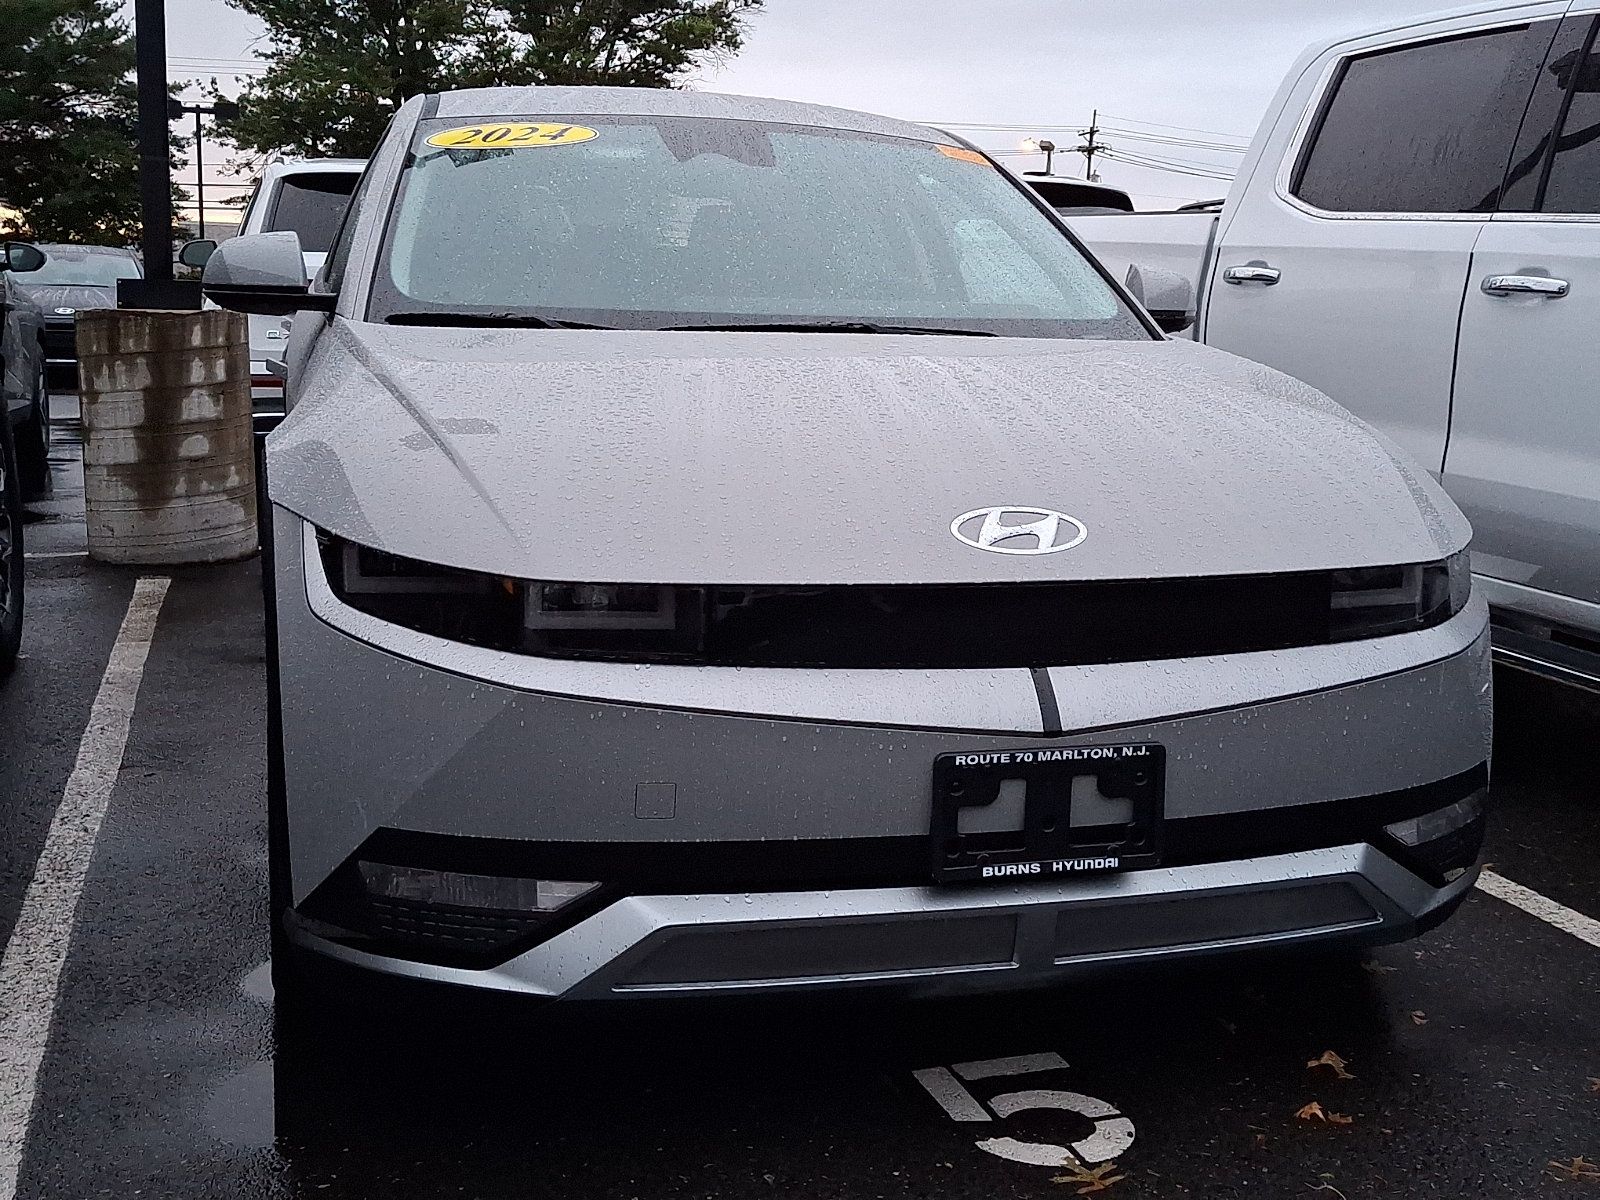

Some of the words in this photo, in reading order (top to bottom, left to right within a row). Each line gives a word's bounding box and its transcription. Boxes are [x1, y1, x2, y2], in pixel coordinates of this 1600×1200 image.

[450, 126, 573, 145] 2024
[955, 753, 1011, 766] ROUTE
[1014, 752, 1034, 763] 70
[1037, 747, 1118, 762] MARLTON,
[1121, 745, 1150, 757] N.J.
[982, 863, 1041, 878] BURNS
[1052, 857, 1119, 872] HYUNDAI
